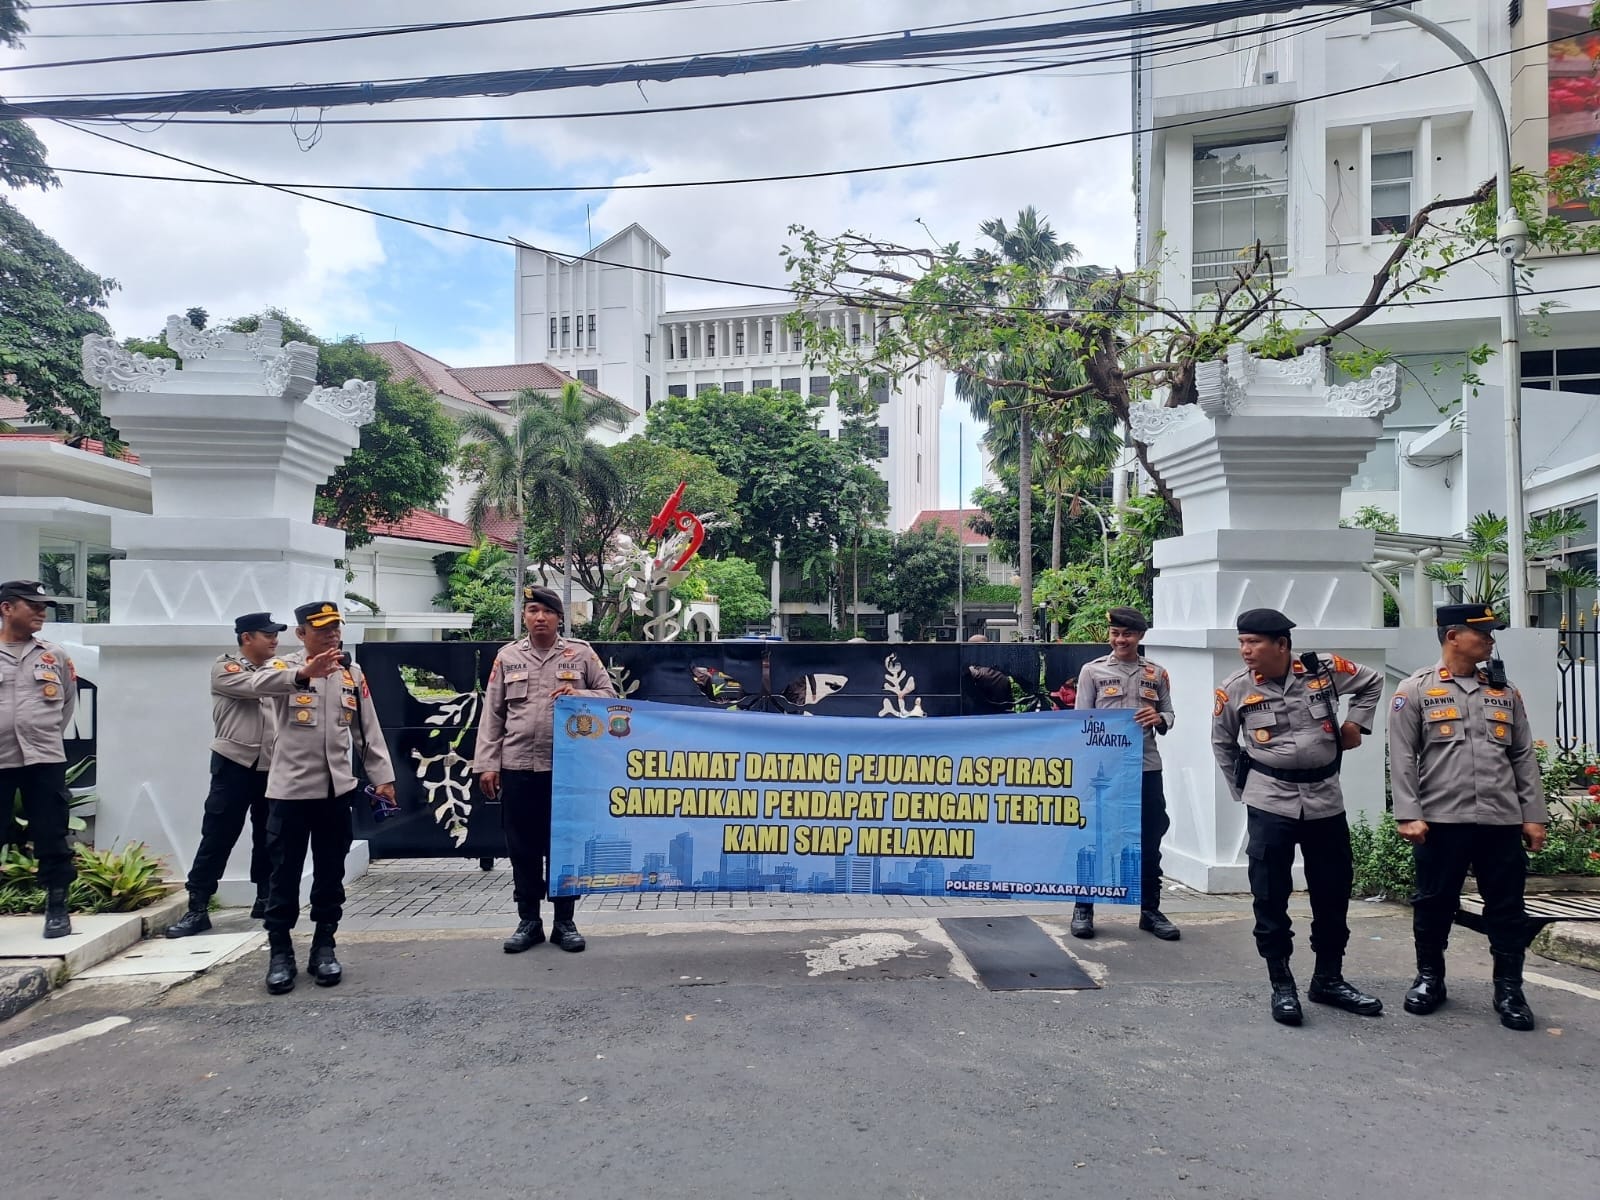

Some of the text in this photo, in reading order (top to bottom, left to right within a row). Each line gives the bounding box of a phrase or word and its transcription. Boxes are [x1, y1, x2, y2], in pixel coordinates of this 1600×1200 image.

[1424, 697, 1455, 706] DARWIN
[1483, 698, 1512, 707] POLRI
[1081, 719, 1106, 734] JAGA
[626, 749, 1073, 787] SELAMAT DATANG PEJUANG ASPIRASI
[609, 787, 1087, 829] SAMPAIKAN PENDAPAT DENGAN TERTIB,
[723, 824, 975, 858] KAMI SIAP MELAYANI
[563, 873, 643, 888] PRESISI
[946, 880, 1127, 897] POLRES METRO JAKARTA PUSAT
